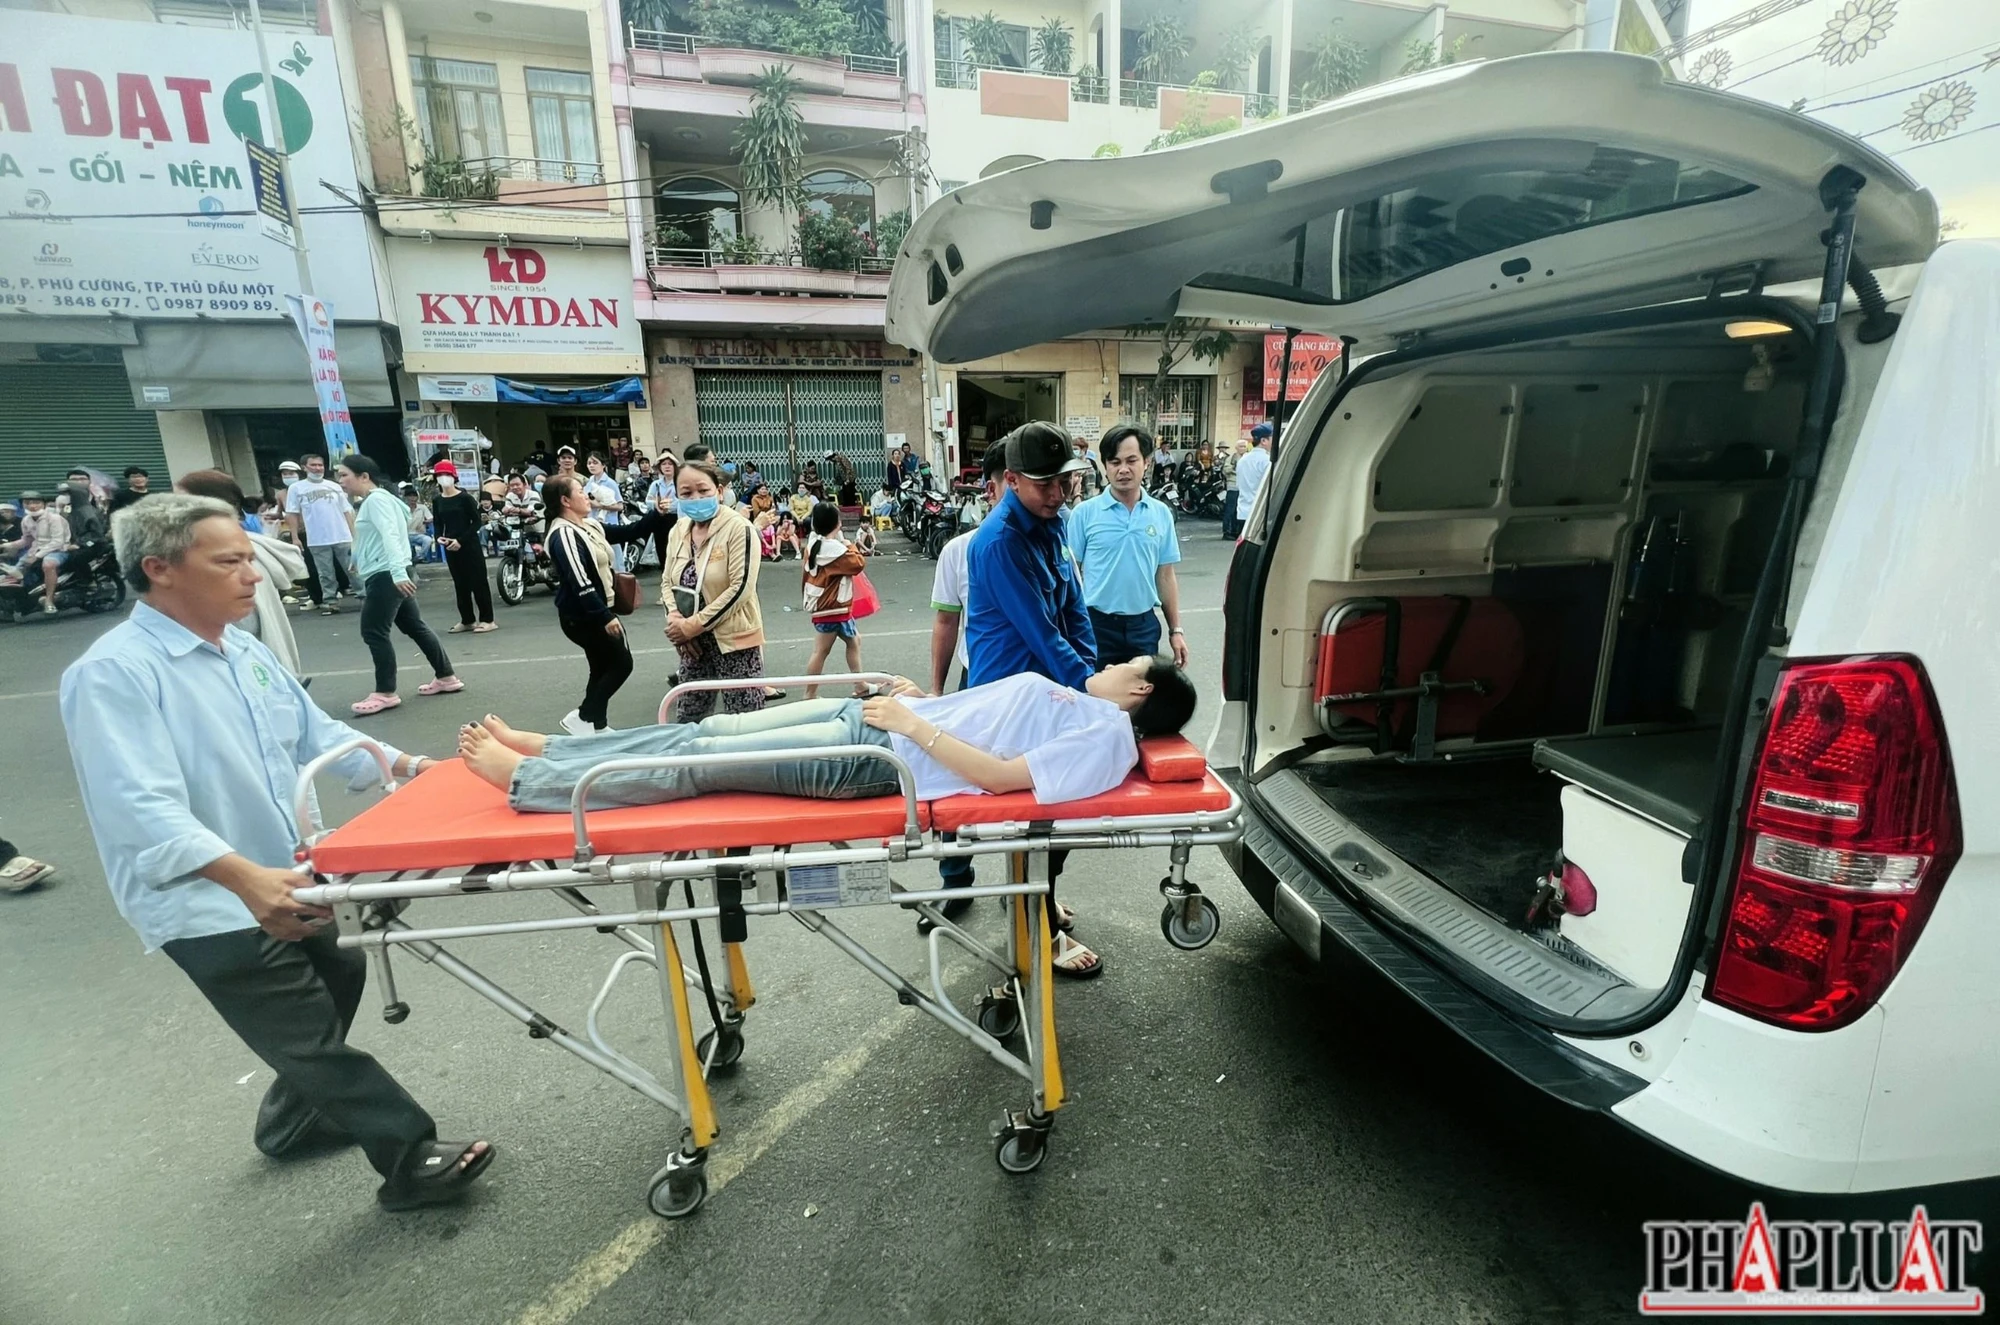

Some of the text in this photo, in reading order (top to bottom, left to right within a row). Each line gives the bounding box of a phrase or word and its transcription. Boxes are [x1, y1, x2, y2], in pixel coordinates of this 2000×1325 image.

[51, 67, 212, 149] ĐẠT
[69, 151, 126, 184] GỐI
[167, 159, 243, 193] NỆM
[187, 219, 245, 230] honeymoon
[191, 253, 260, 265] EVERON
[20, 277, 35, 290] P.
[145, 281, 168, 294] TP.
[171, 280, 203, 294] THỦ
[243, 283, 275, 298] MỘT
[53, 295, 97, 308] 3848
[164, 298, 203, 310] 0987
[209, 299, 249, 311] 8909
[417, 293, 619, 329] KYMDAN
[1293, 338, 1317, 351] HÀNG
[1318, 339, 1336, 351] KÉT
[723, 357, 751, 365] HONDA
